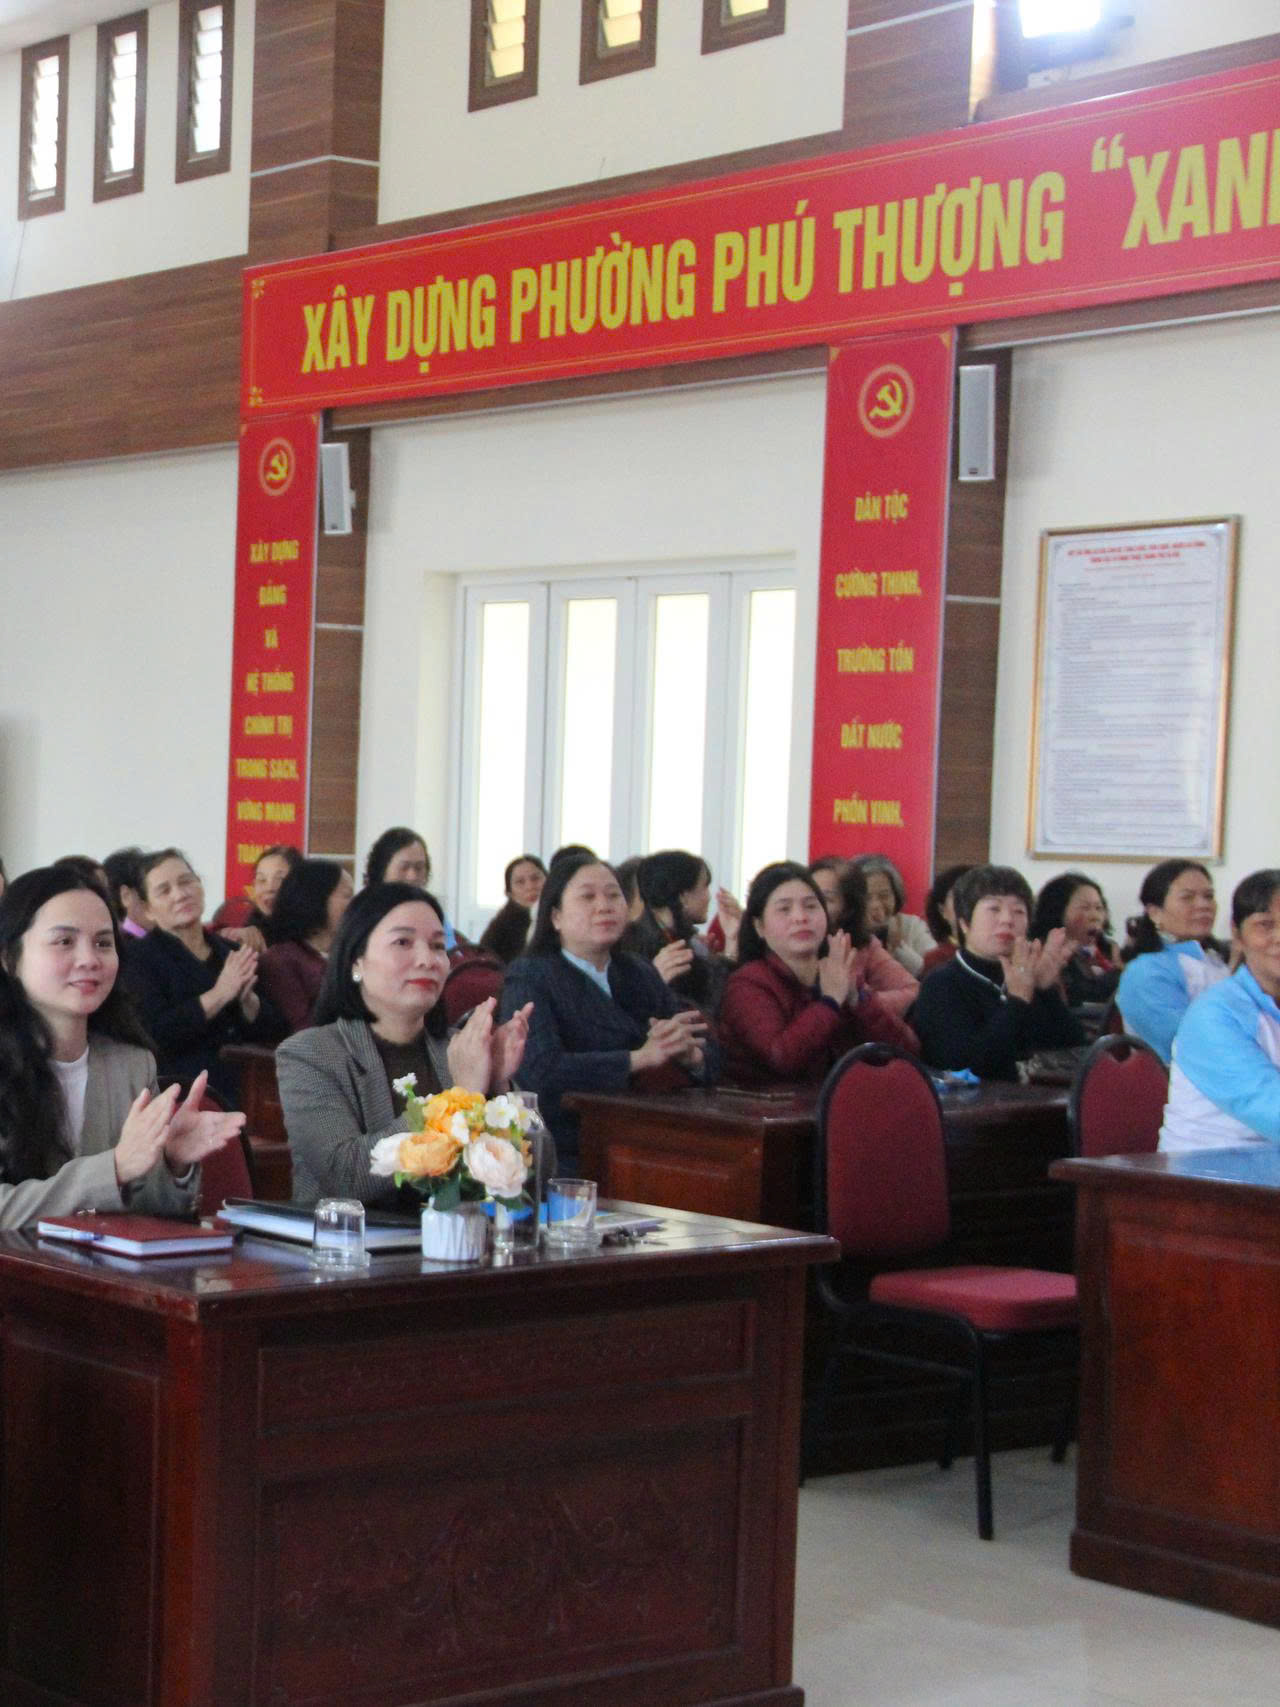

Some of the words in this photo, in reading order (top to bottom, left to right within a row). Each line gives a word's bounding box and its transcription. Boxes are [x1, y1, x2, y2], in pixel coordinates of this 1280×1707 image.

[301, 284, 376, 374] XÂY
[386, 273, 496, 374] DỰNG
[510, 231, 697, 344] PHƯỜNG
[711, 199, 816, 313] PHÚ
[832, 171, 1065, 297] THƯỢNG
[854, 492, 882, 521] DÂN
